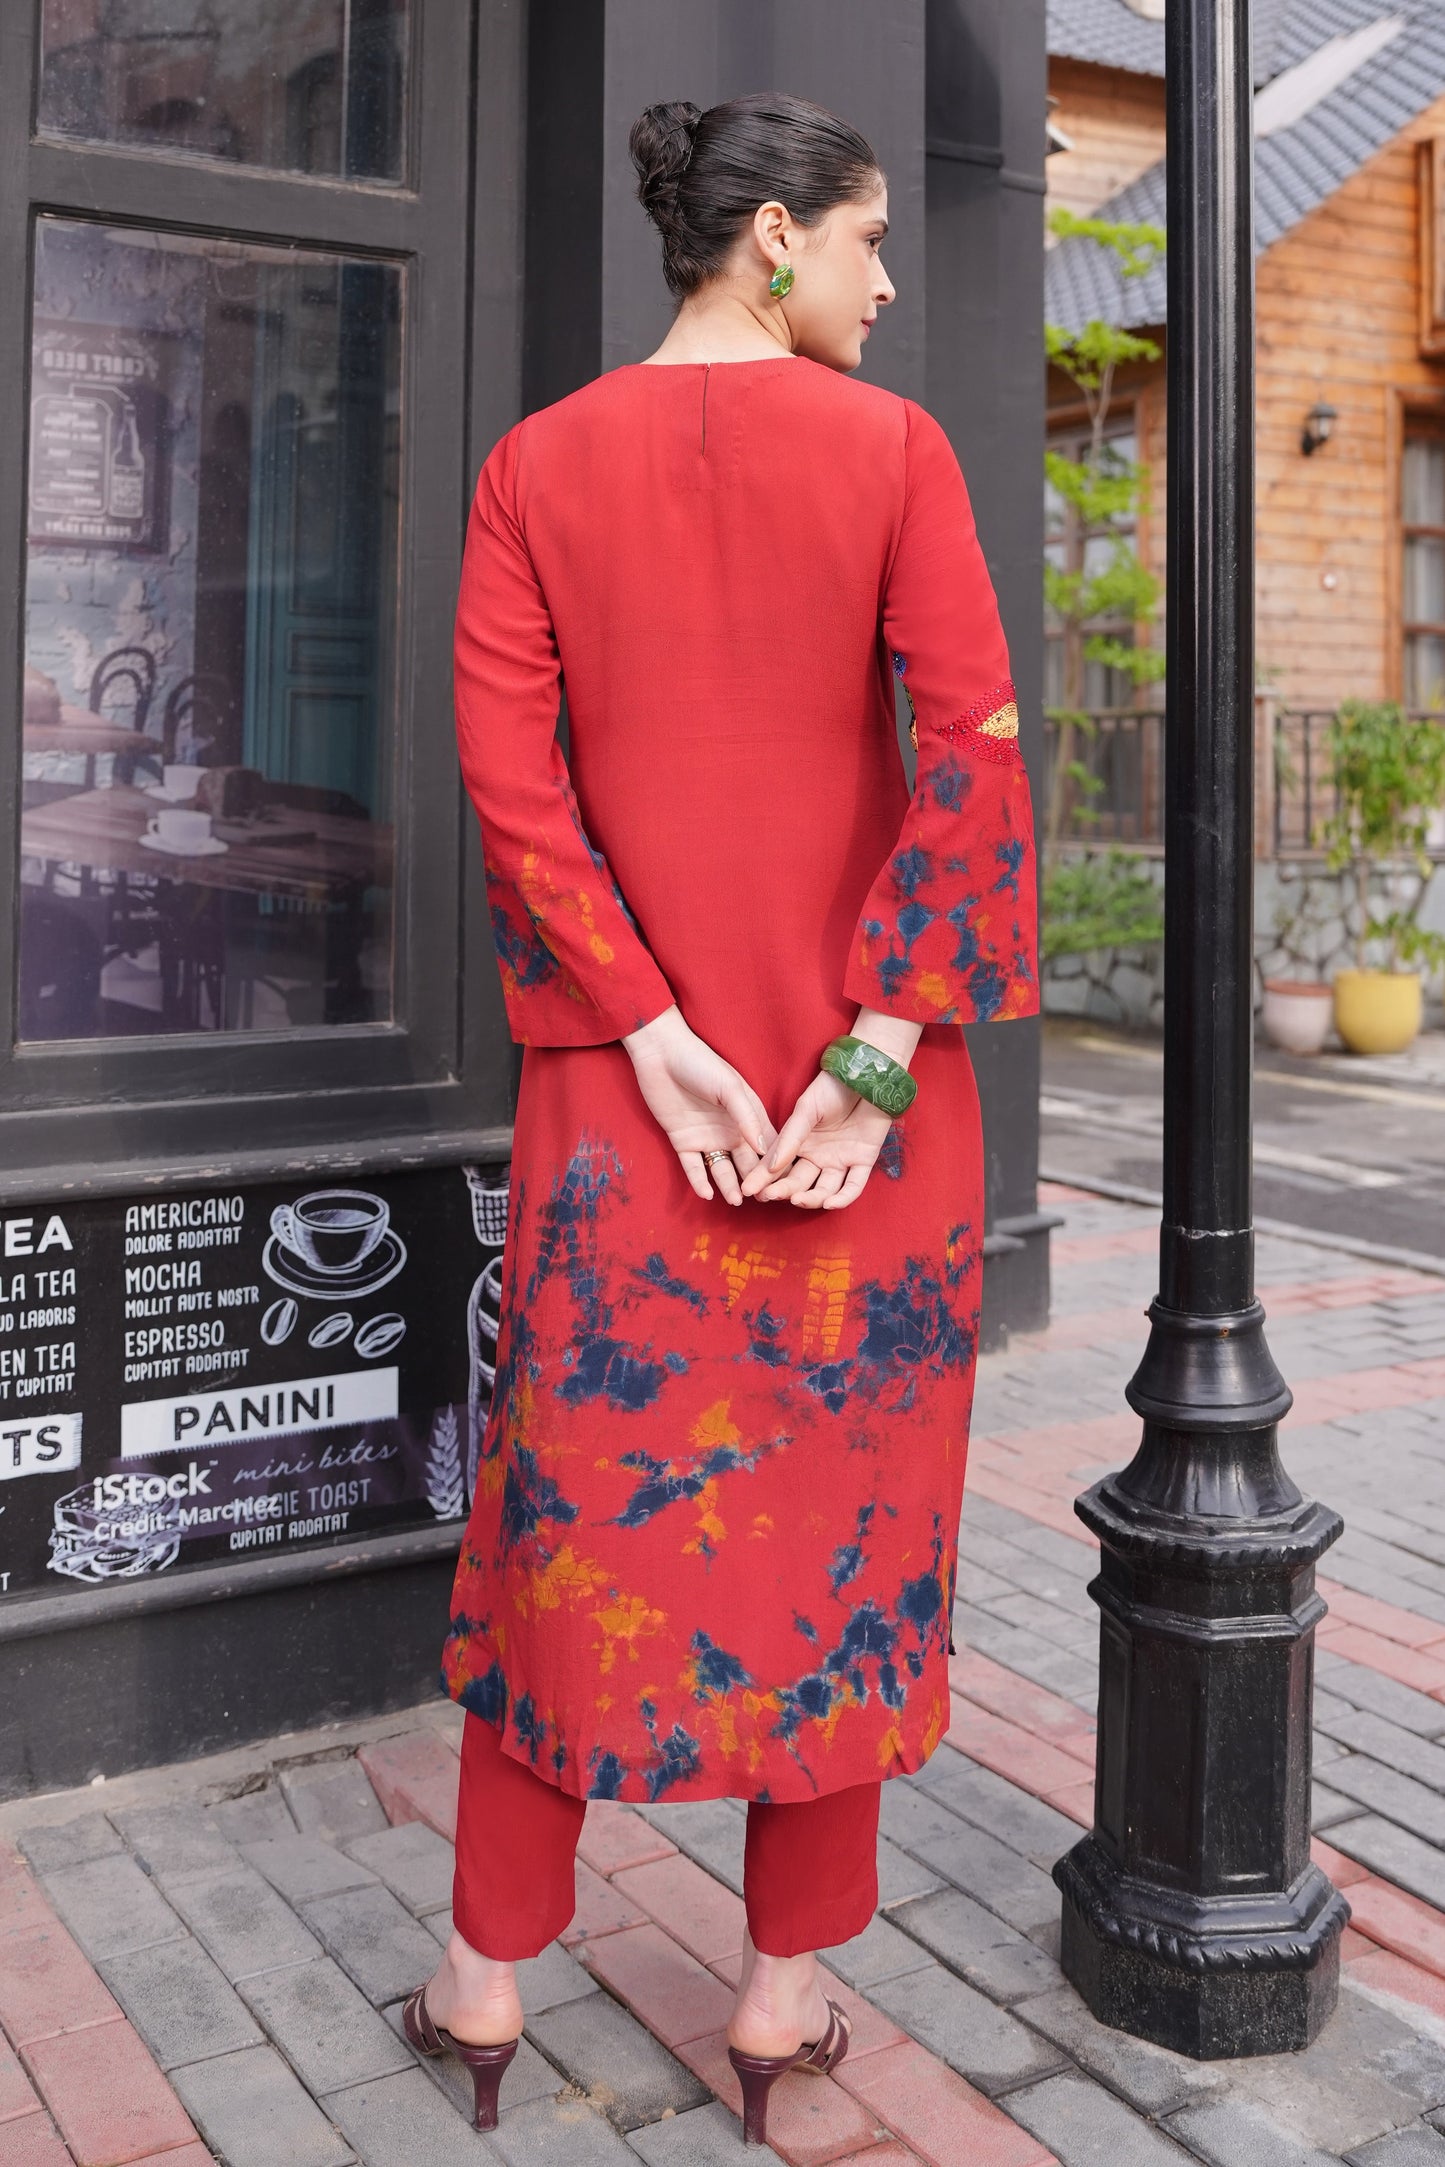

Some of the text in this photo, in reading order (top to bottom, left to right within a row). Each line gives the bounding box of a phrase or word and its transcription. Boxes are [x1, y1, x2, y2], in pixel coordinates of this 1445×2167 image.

[125, 1195, 244, 1233] AMERICANO
[0, 1215, 74, 1257] EA
[125, 1226, 242, 1256] DOLORE ADDATAT
[34, 1268, 76, 1299] TEA
[125, 1260, 201, 1295] MOCHA
[19, 1305, 76, 1330] LABORIS
[125, 1285, 260, 1319] MOLLIT AUTE NOSTR
[125, 1320, 225, 1358] ESPRESSO
[34, 1341, 76, 1373] TEA
[124, 1348, 250, 1383] CUPITAT ADDATAT
[16, 1372, 76, 1398] CUPITAT
[174, 1385, 334, 1441] PANINI
[233, 1439, 398, 1484] mini bites
[307, 1478, 372, 1512] TOAST
[93, 1514, 173, 1541] Credit:
[229, 1511, 350, 1550] CUPITAT ADDATAT
